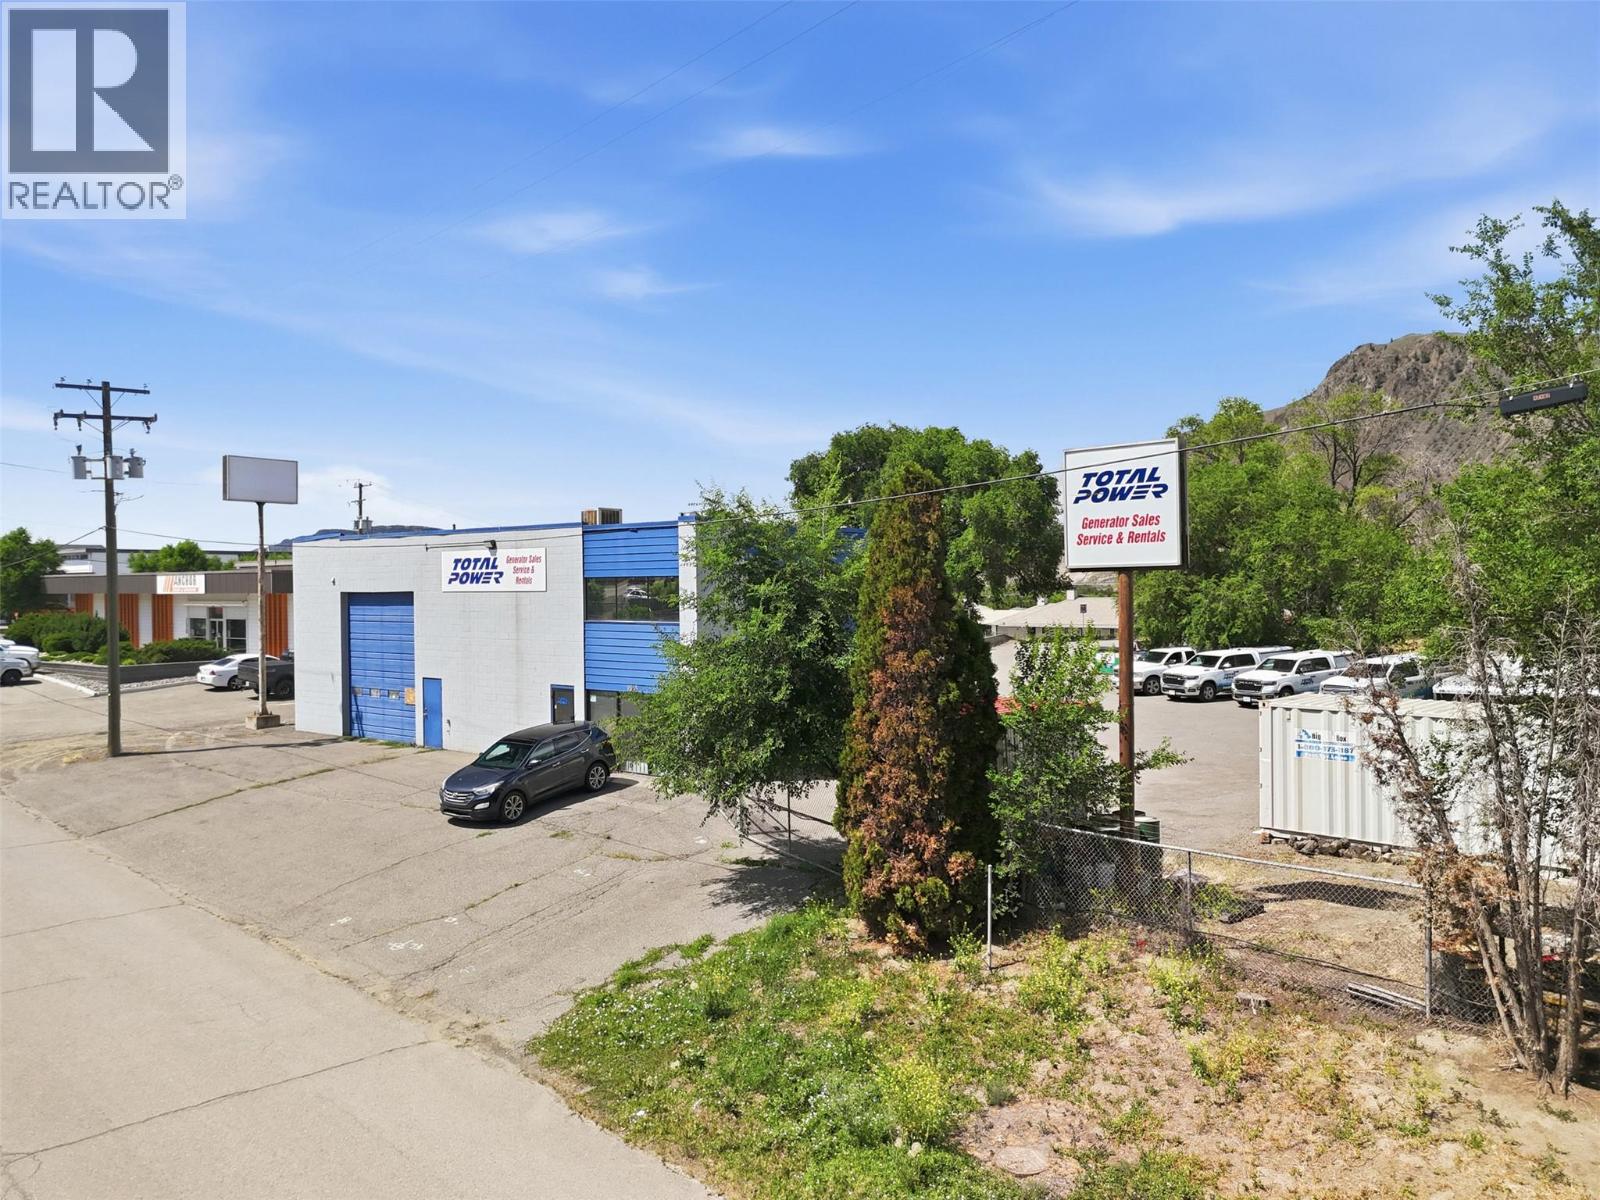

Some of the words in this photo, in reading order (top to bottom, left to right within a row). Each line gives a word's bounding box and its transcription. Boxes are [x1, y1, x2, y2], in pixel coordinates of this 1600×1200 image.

[1082, 466, 1161, 488] TOTAL
[1073, 483, 1169, 504] POWER
[1081, 515, 1129, 530] Generator
[1131, 513, 1160, 528] Sales
[1076, 532, 1113, 546] Service
[1115, 531, 1124, 544] &
[1127, 529, 1166, 544] Rentals
[452, 557, 498, 571] TOTAL
[506, 556, 528, 564] Generator
[529, 555, 542, 563] Sales
[513, 566, 530, 574] Service
[531, 565, 535, 574] &
[448, 571, 504, 585] POWER
[515, 576, 533, 585] Rentals
